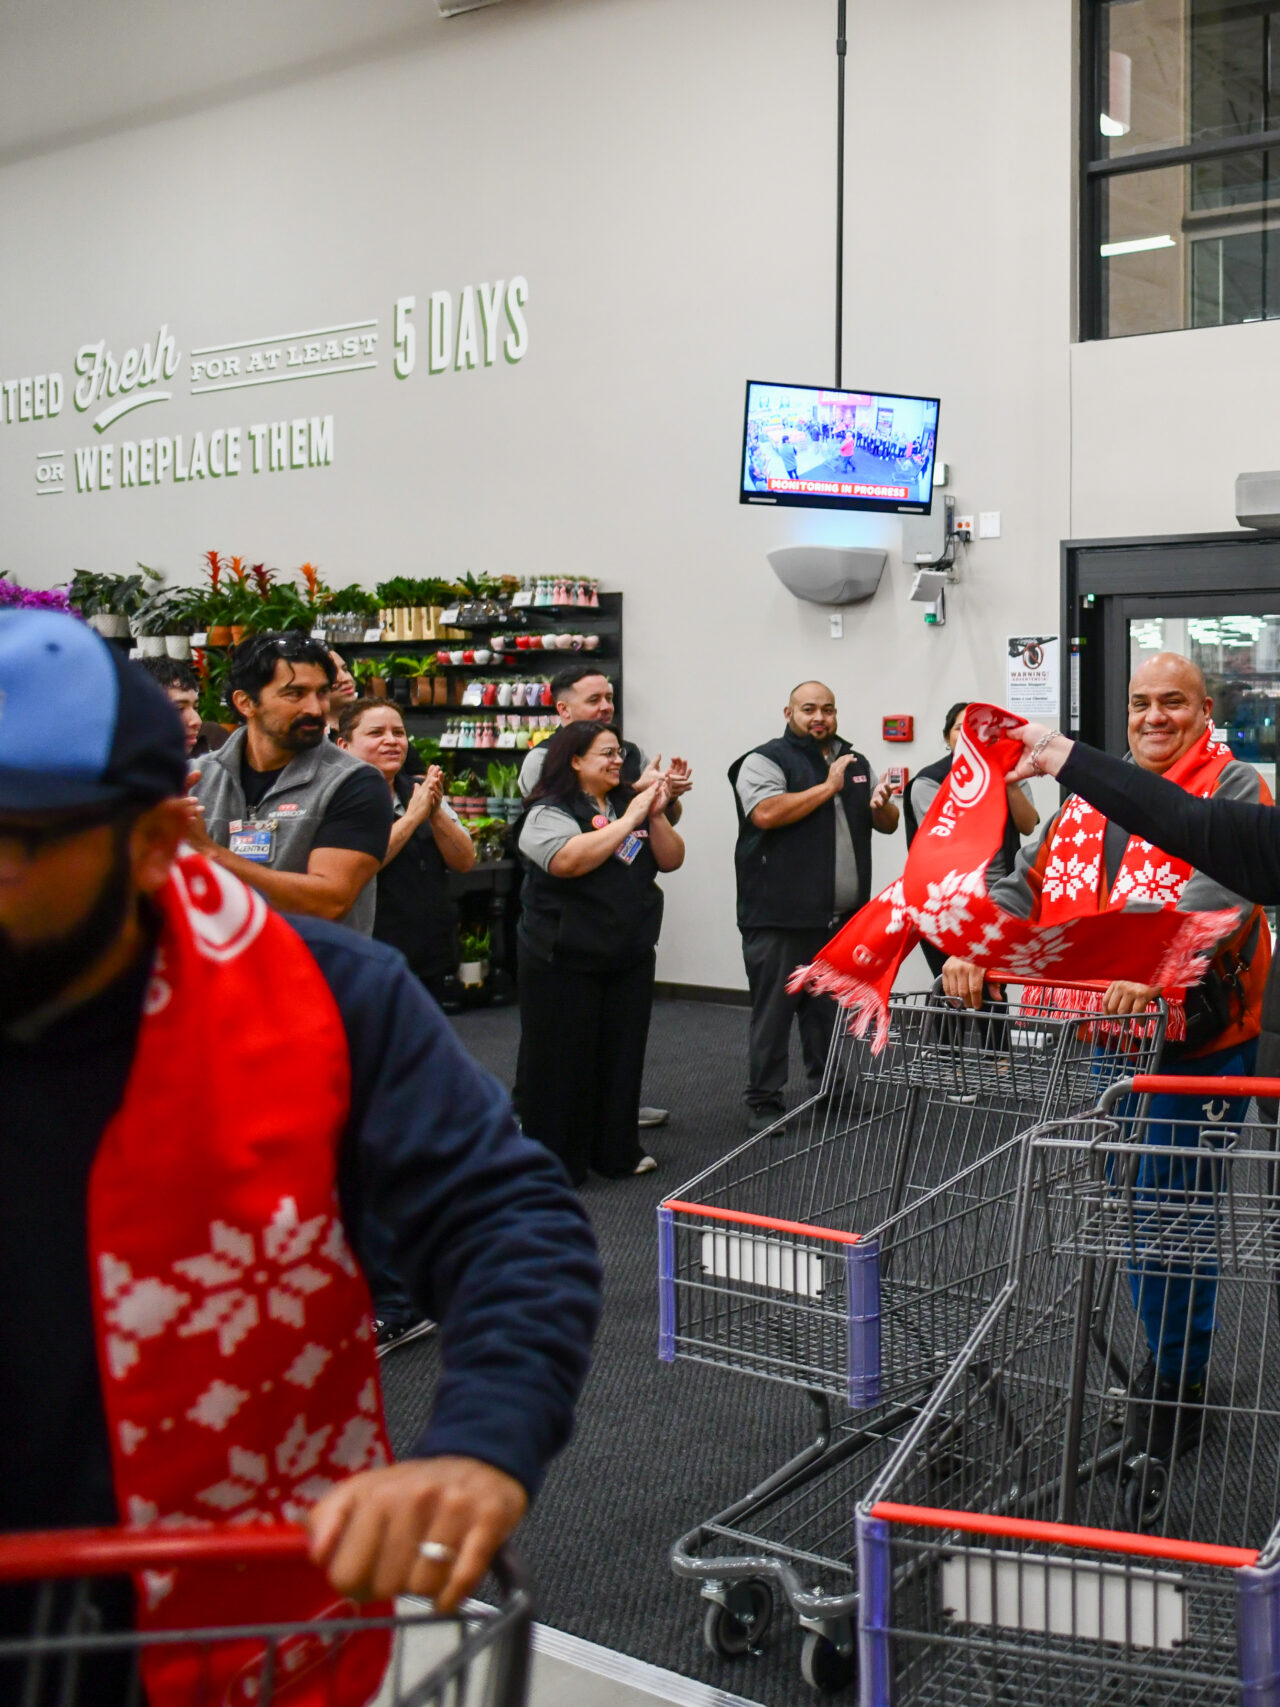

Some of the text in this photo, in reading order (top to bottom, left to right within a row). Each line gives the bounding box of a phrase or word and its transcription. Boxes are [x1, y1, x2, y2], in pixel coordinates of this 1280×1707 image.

[0, 275, 528, 424] TEED Fresh FOR AT LEAST 5 DAYS
[36, 415, 334, 493] OR WE REPLACE THEM
[770, 479, 906, 497] MONITORING IN PROGRESS
